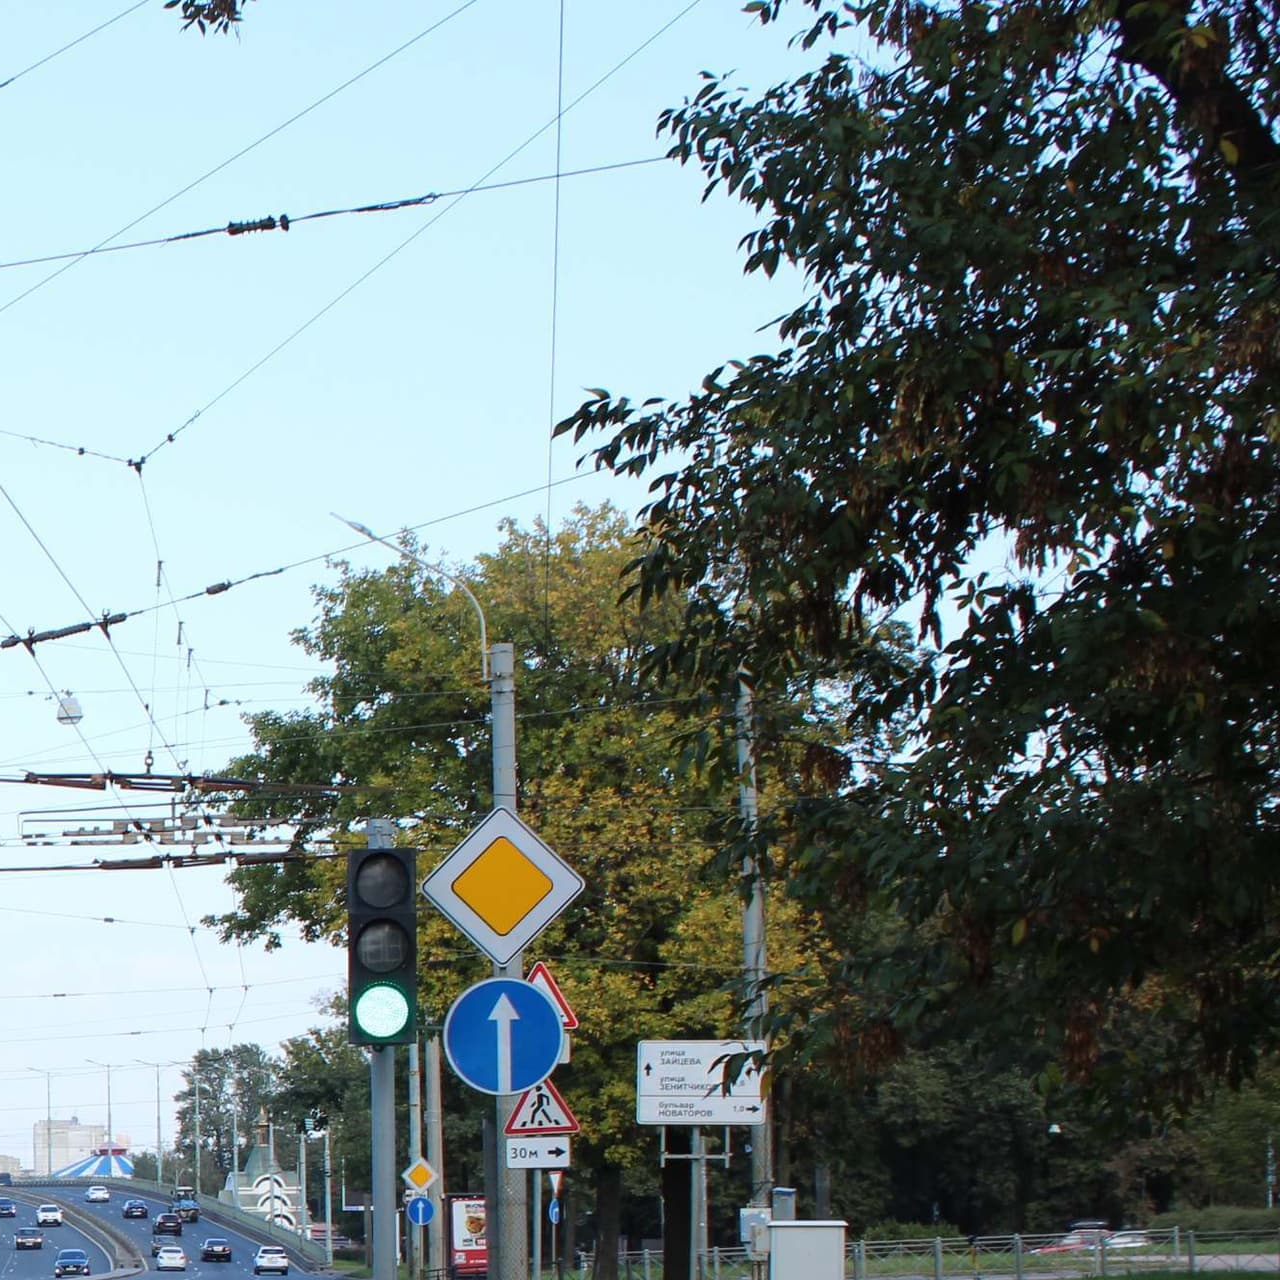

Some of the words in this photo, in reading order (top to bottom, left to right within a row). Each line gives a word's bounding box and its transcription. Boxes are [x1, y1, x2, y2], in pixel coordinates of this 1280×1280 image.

[660, 1058, 701, 1066] ЗАЙЦЕВА
[659, 1083, 713, 1091] ЗЕНИТЧИКО
[658, 1109, 712, 1117] НОВАТОРОВ
